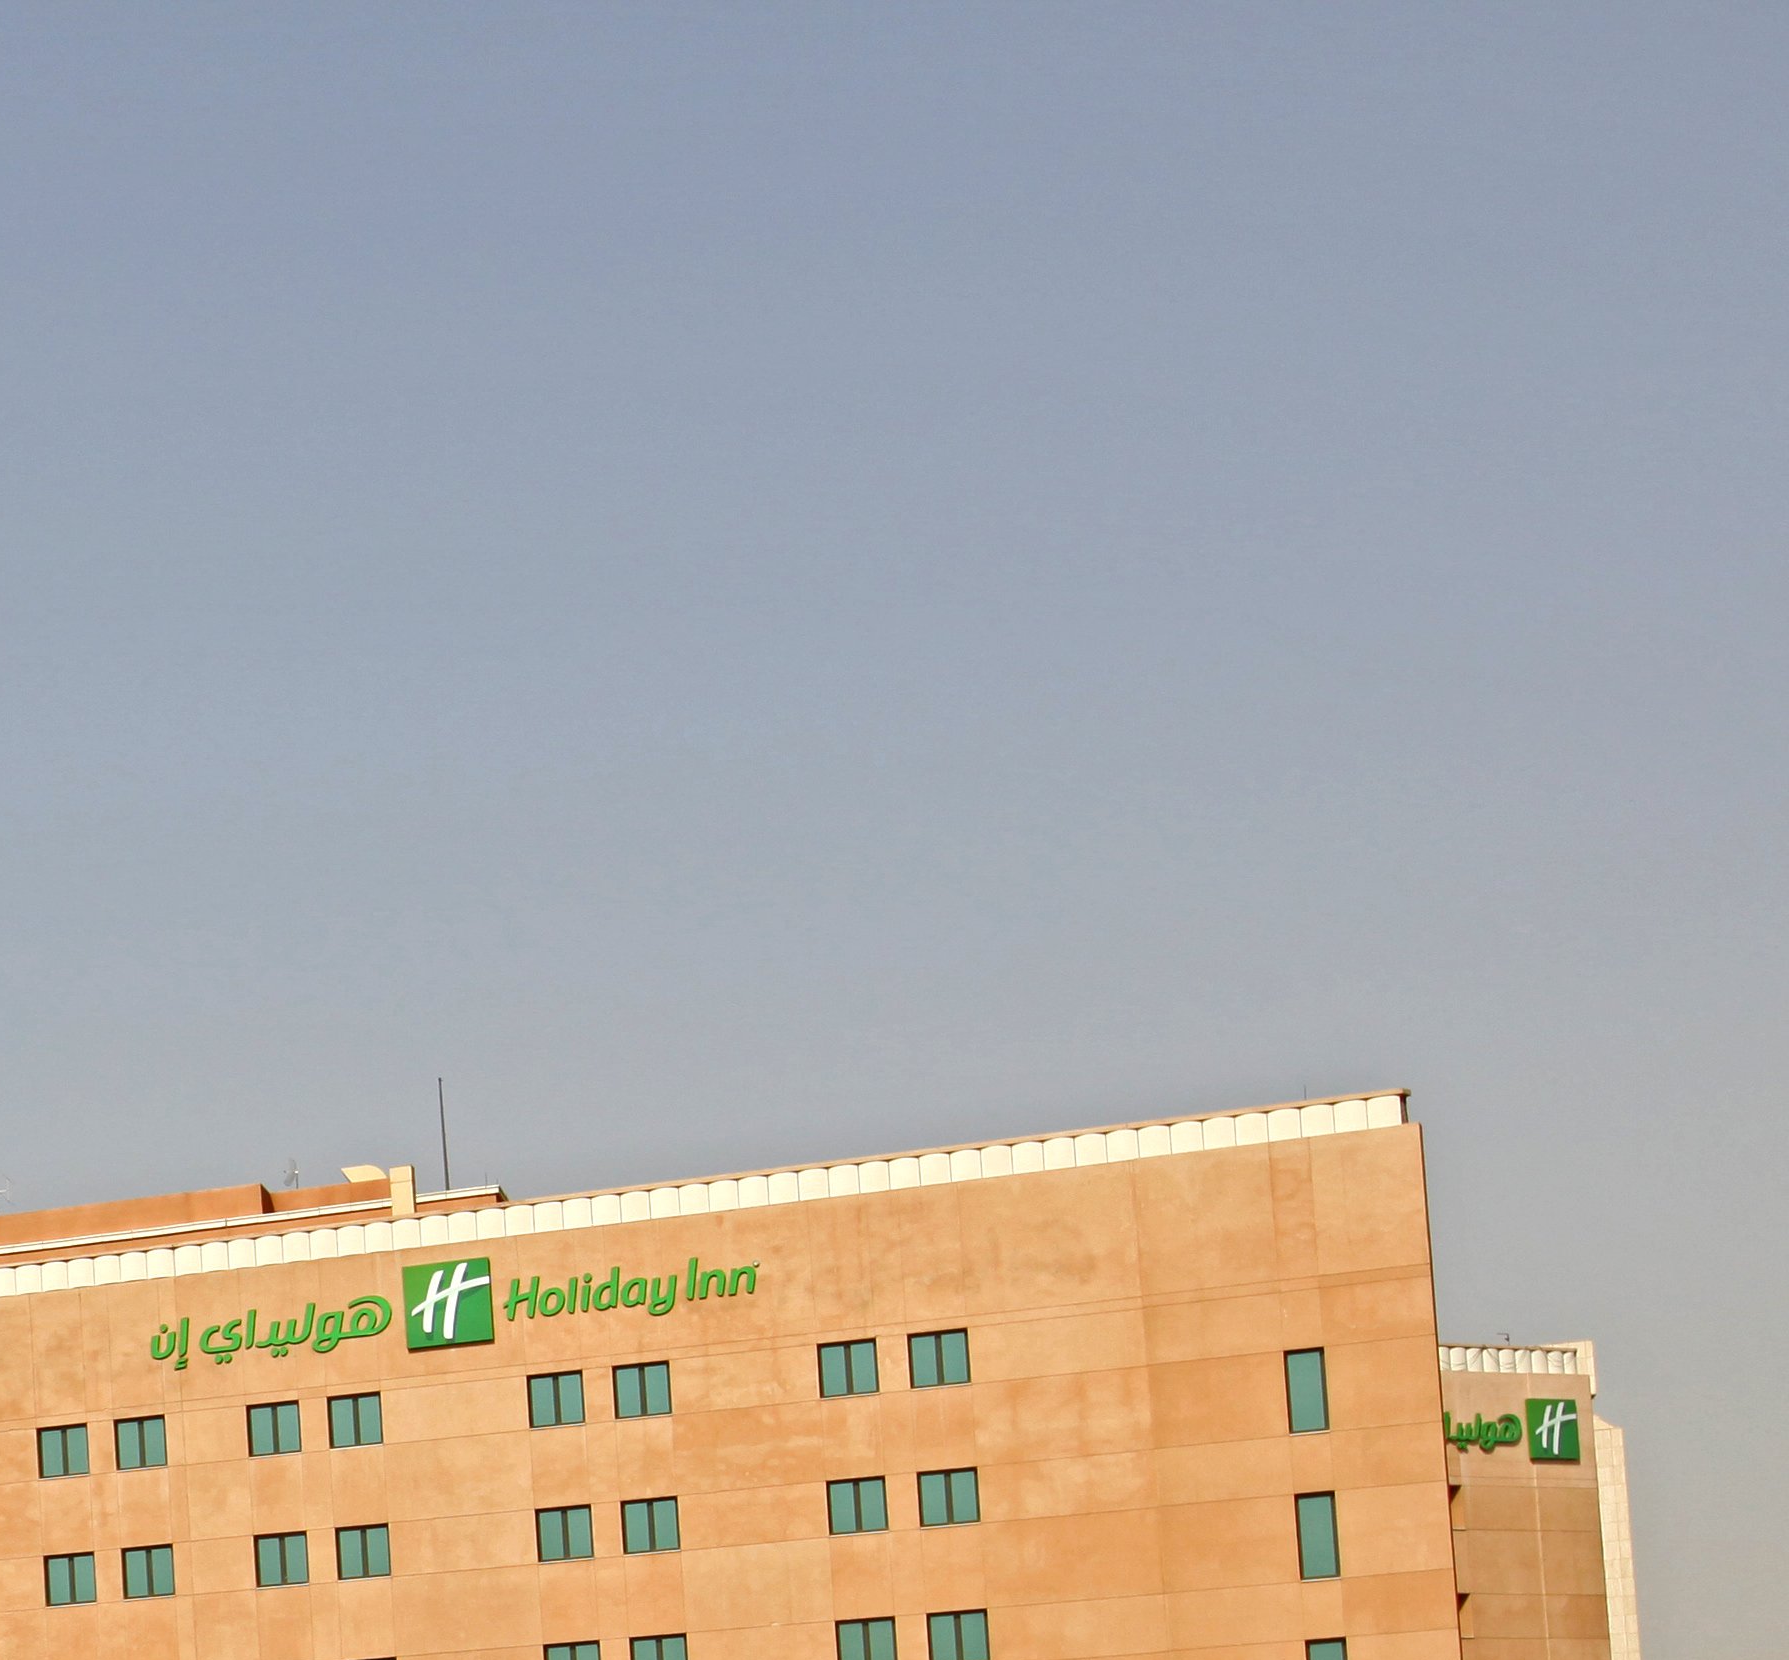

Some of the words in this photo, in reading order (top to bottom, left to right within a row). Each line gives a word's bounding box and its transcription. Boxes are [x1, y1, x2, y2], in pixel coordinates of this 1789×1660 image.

[503, 1266, 678, 1322] Holiday
[685, 1257, 758, 1300] Inn
[150, 1316, 190, 1371] إن
[198, 1295, 393, 1364] هوليداي
